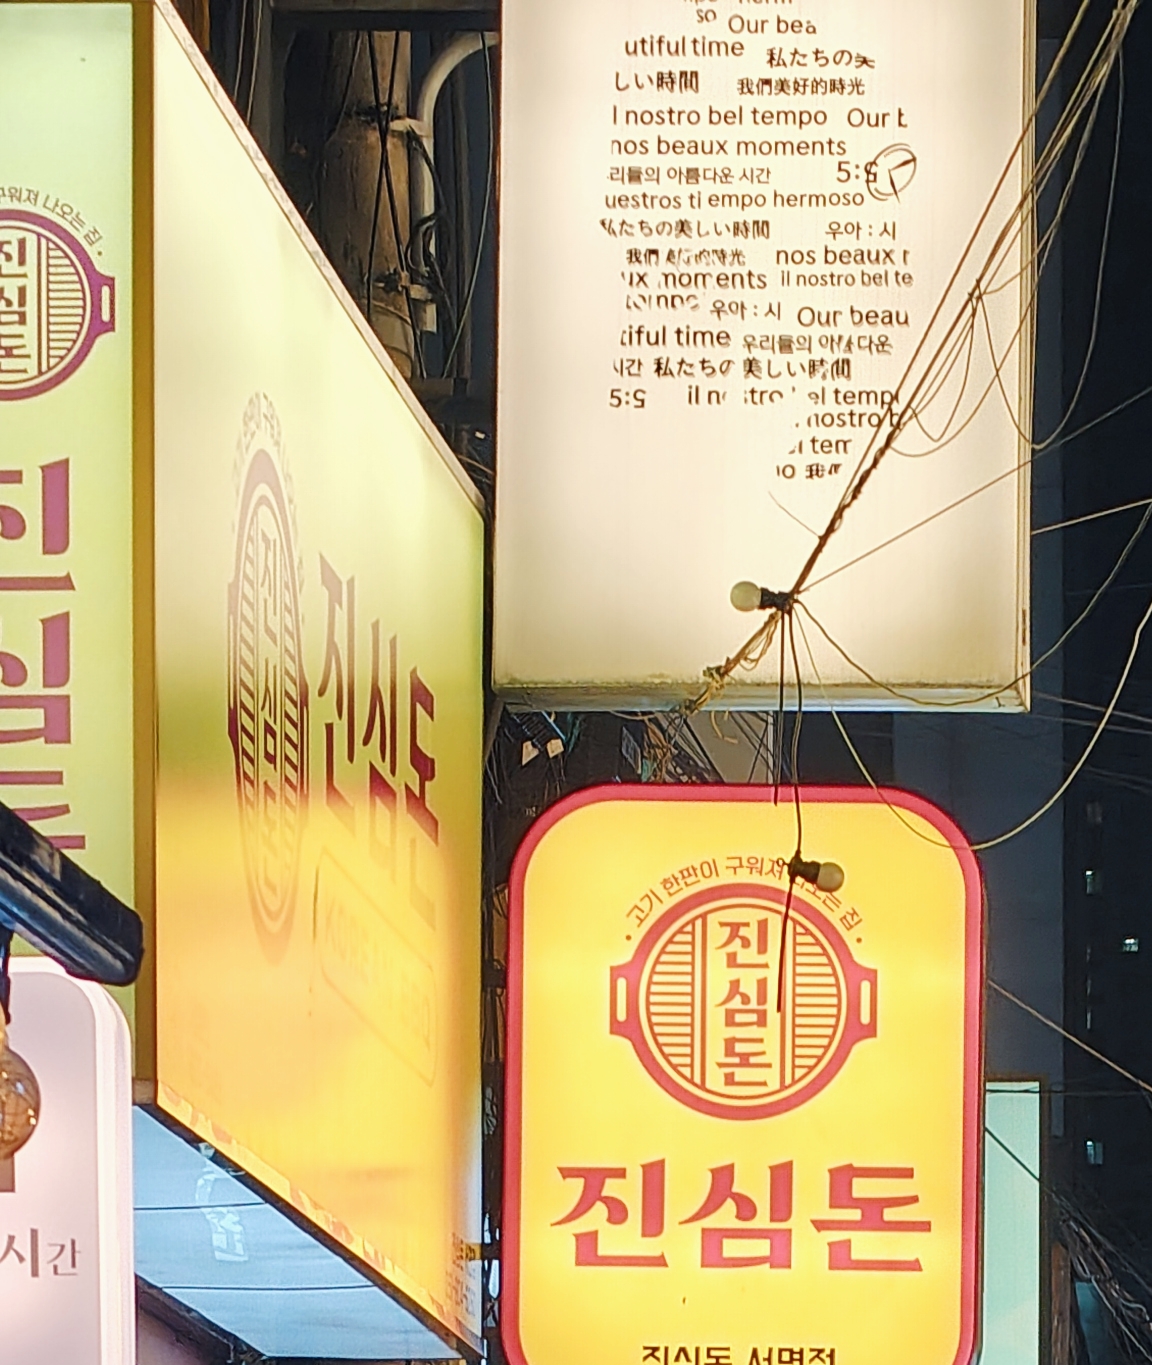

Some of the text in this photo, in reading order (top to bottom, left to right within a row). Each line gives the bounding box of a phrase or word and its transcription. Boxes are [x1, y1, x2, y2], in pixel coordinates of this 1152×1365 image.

[727, 14, 769, 34] Our
[624, 35, 745, 58] utiful time
[624, 106, 701, 126] nostro
[708, 105, 744, 126] bel
[752, 106, 828, 130] tempo
[847, 107, 891, 128] Our
[611, 135, 848, 156] nos beaux moments
[738, 166, 772, 186] 시간
[0, 186, 40, 207] 워져
[773, 189, 866, 208] hermoso
[776, 248, 817, 266] nos
[823, 245, 896, 266] beaux
[796, 270, 856, 288] nostro
[861, 268, 890, 288] bel
[796, 305, 911, 327] Our beau
[674, 325, 732, 347] time
[626, 888, 664, 928] 고기
[660, 858, 720, 898] 한판이
[838, 907, 863, 932] 집
[715, 916, 773, 1088] 진심돈
[550, 1158, 932, 1273] 진심돈
